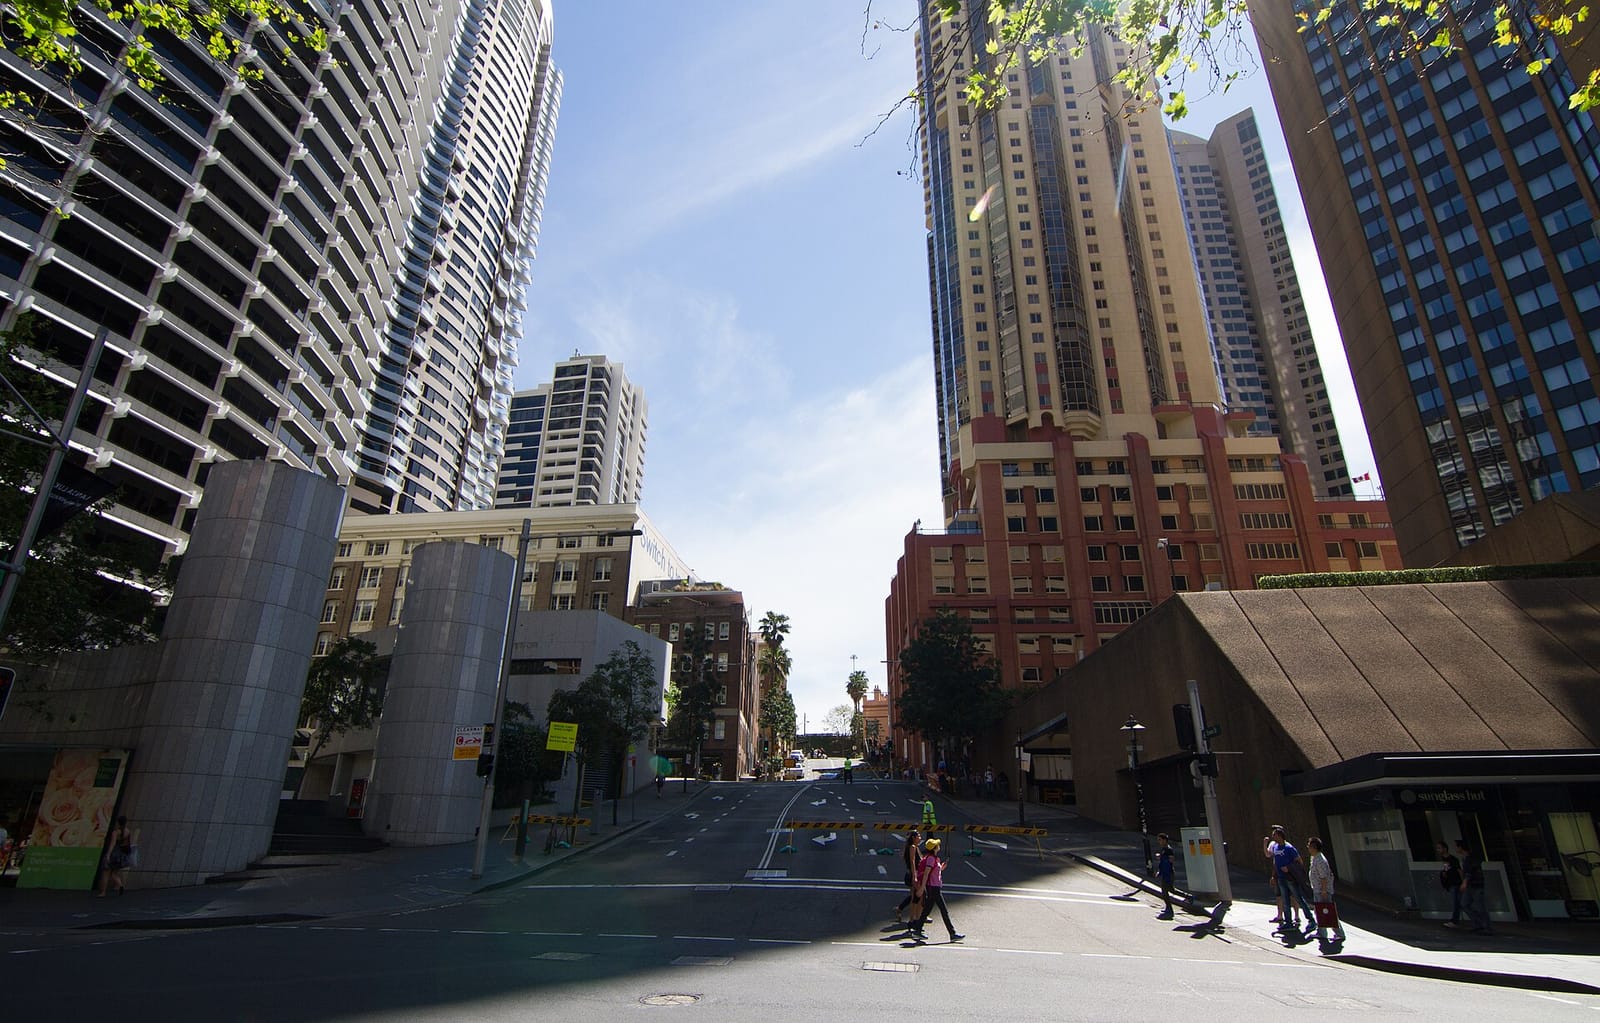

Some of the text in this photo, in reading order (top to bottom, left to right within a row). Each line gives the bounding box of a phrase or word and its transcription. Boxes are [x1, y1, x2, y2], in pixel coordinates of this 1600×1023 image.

[640, 524, 666, 572] Switch
[1417, 789, 1486, 804] sunglass hut
